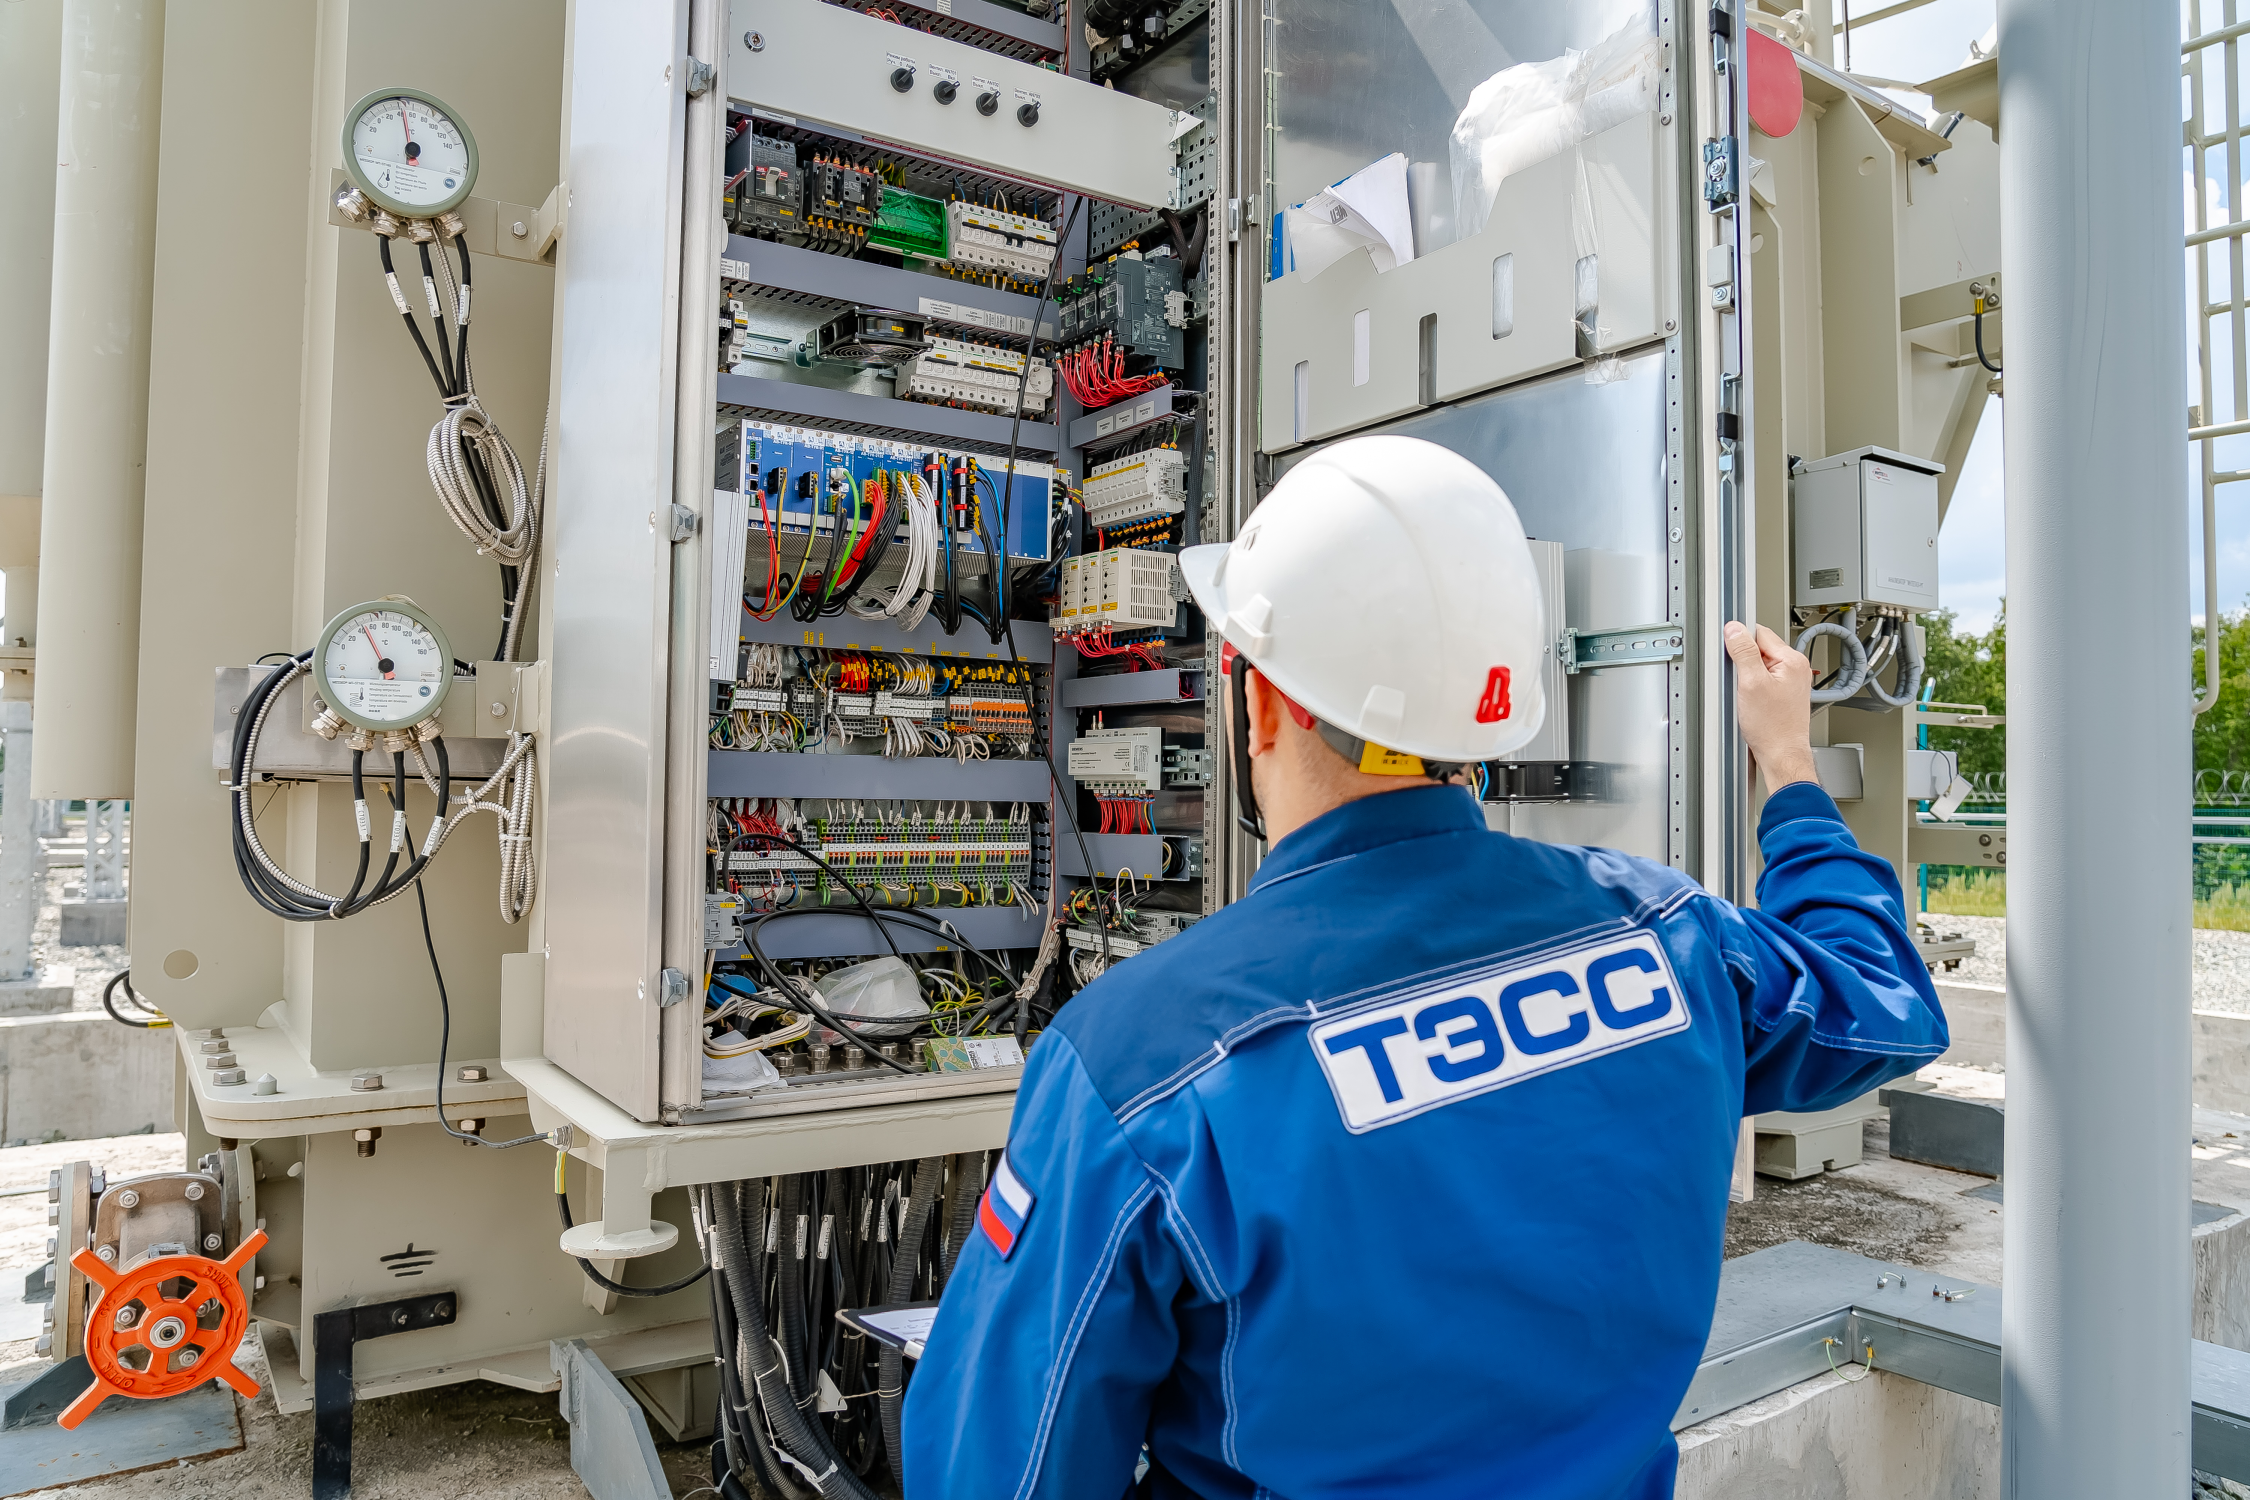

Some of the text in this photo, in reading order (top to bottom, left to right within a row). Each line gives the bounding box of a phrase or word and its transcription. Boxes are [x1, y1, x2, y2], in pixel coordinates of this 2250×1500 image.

[1324, 948, 1672, 1104] ТЭСС
[203, 1266, 233, 1290] SHUT
[101, 1362, 134, 1389] OPEN
